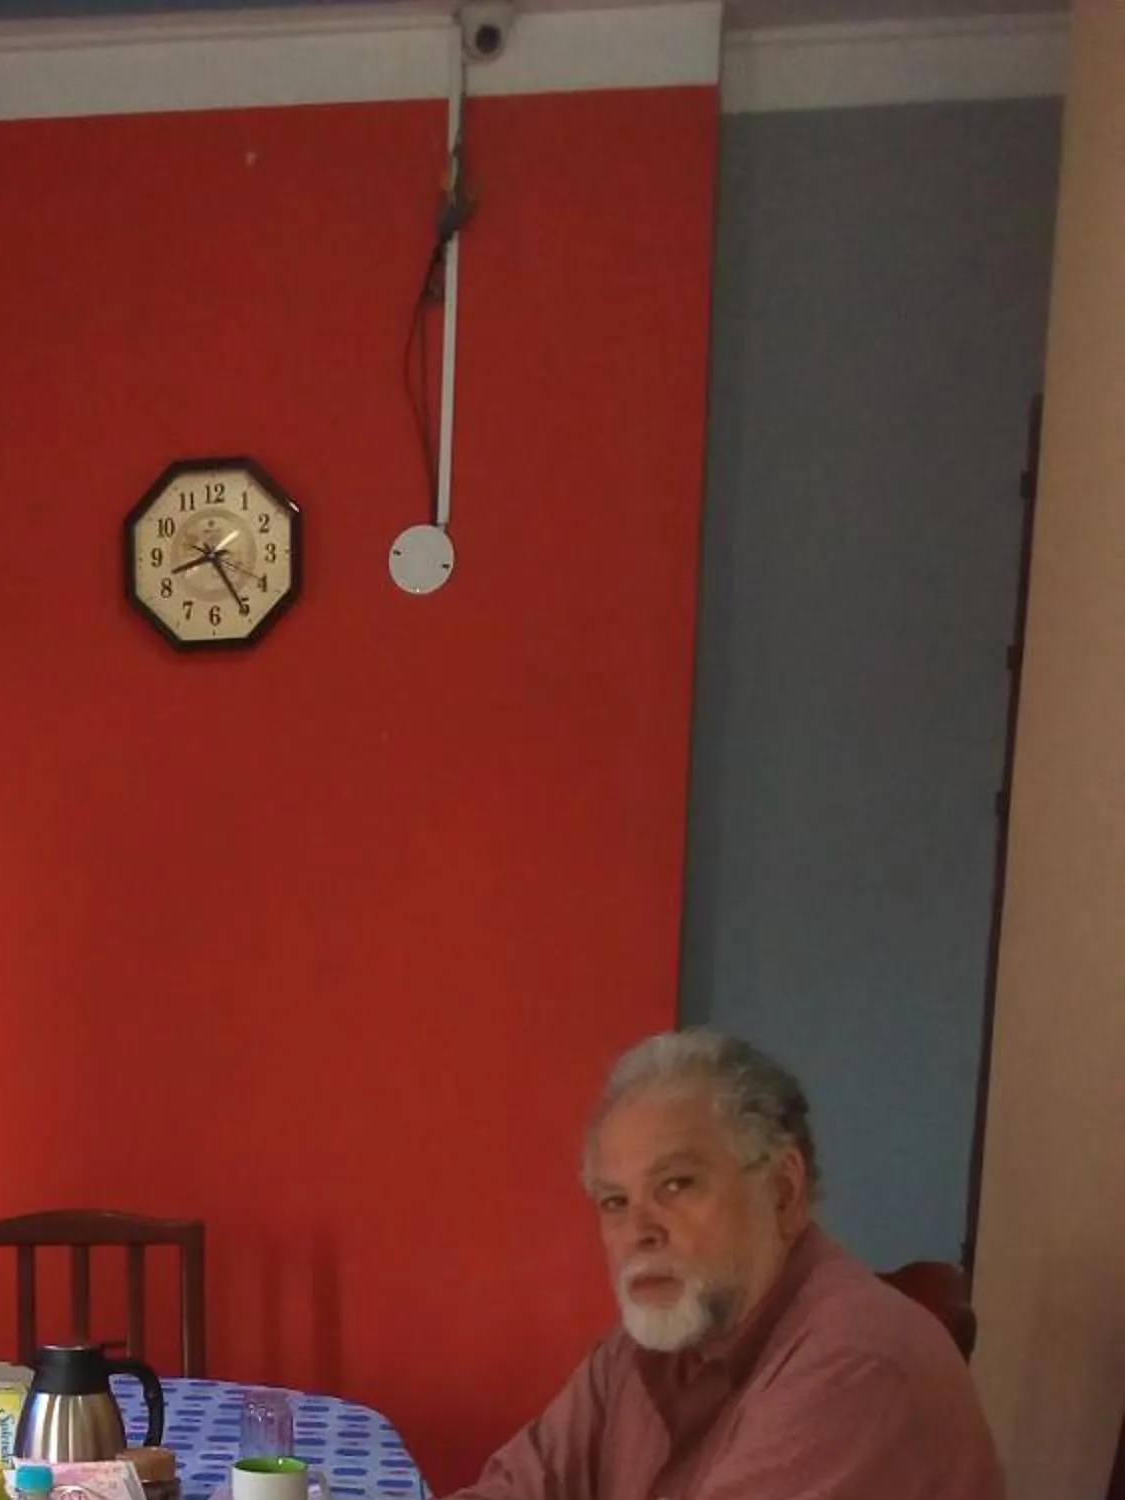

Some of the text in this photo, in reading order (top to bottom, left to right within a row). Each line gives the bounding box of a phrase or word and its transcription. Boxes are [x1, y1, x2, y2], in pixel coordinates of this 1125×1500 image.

[179, 492, 196, 511] 11
[204, 483, 225, 504] 12
[241, 491, 249, 510] 1
[157, 517, 175, 538] 10
[258, 513, 270, 533] 2
[151, 547, 163, 568] 9
[265, 543, 276, 563] 3
[161, 577, 173, 598] 8
[256, 574, 268, 593] 4
[182, 601, 193, 621] 7
[209, 605, 221, 626] 6
[238, 597, 250, 618] 5
